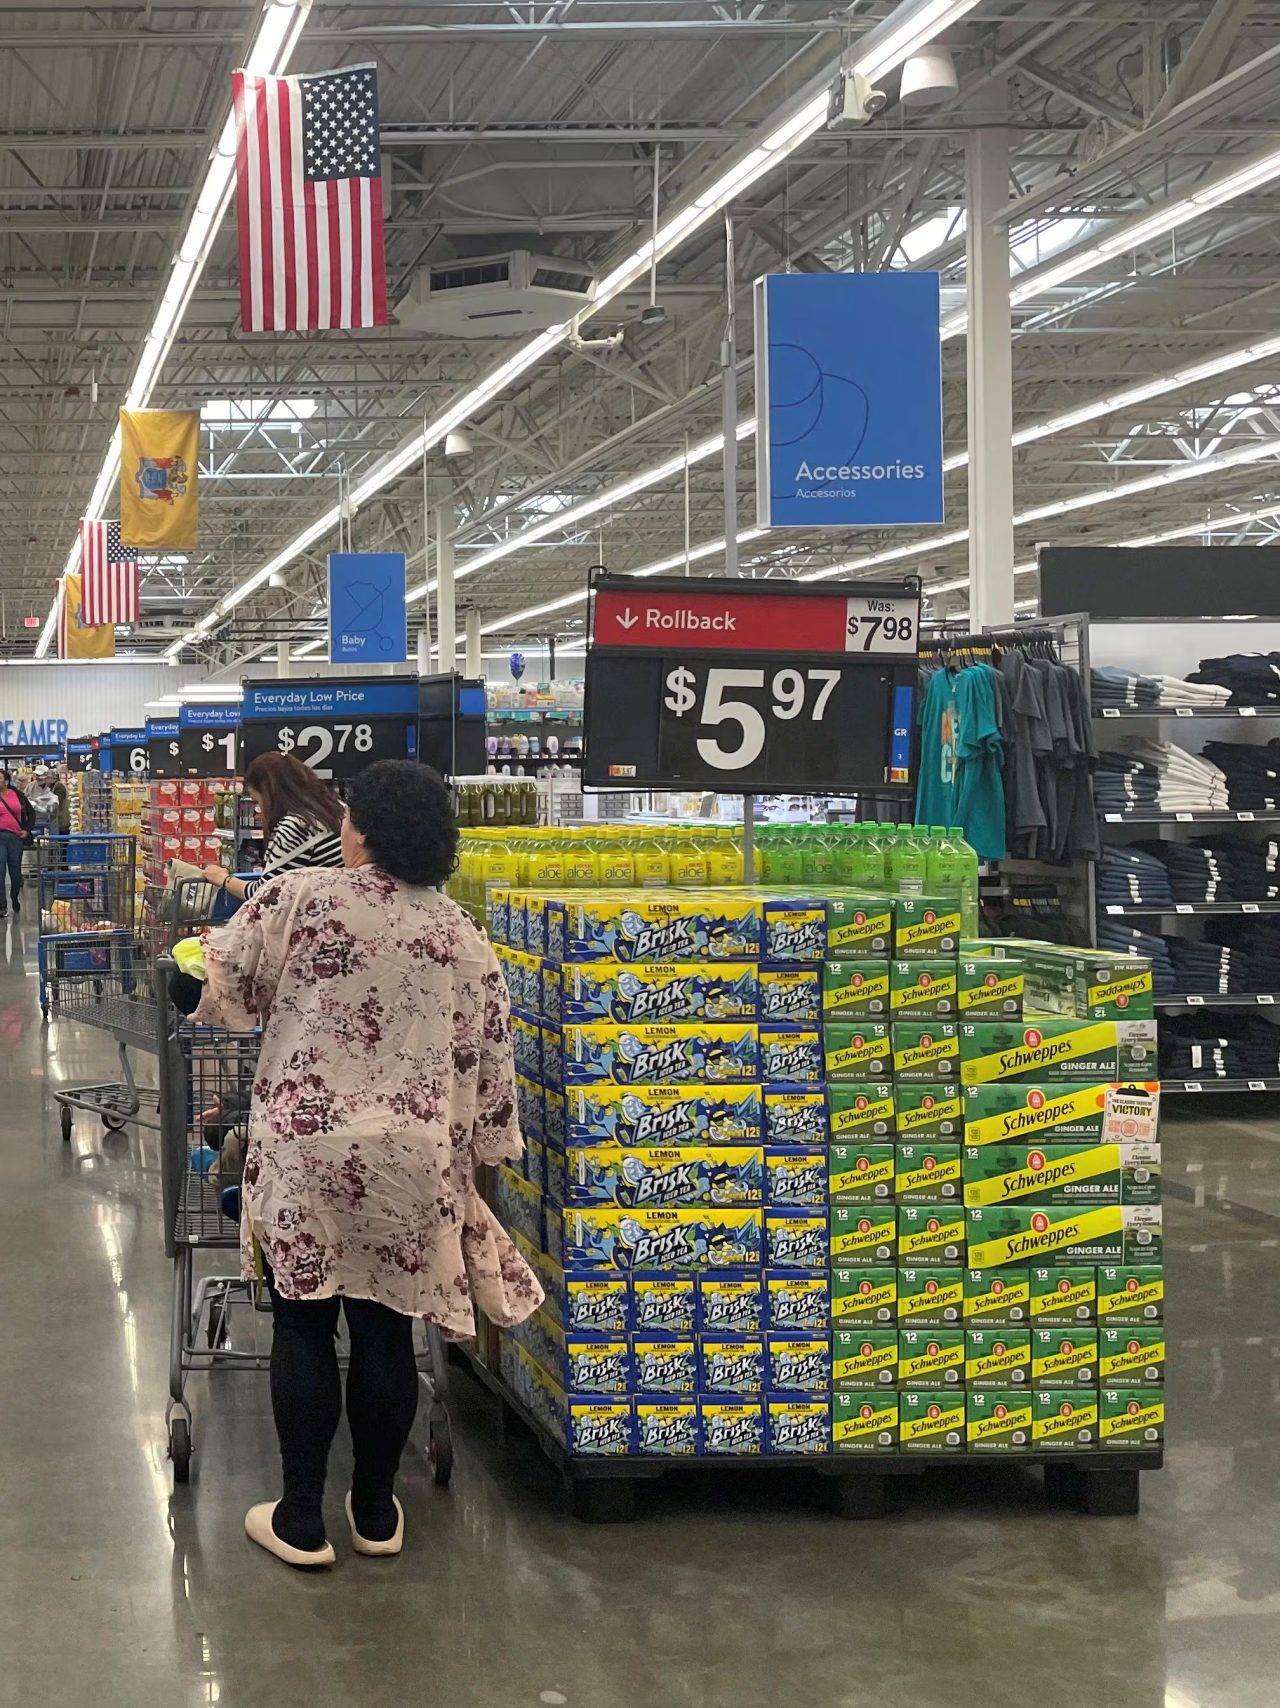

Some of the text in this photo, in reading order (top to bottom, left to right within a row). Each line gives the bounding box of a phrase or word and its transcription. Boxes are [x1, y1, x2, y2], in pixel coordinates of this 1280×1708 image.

[795, 460, 925, 482] Accessories
[796, 487, 856, 498] Accesorios
[867, 600, 895, 613] Was:
[646, 609, 736, 631] Rollback
[341, 635, 366, 647] Baby
[254, 690, 365, 705] Everyday Low Price
[188, 710, 224, 718] Everyday
[894, 728, 907, 737] GR
[833, 902, 845, 910] 12
[837, 920, 885, 942] Schweppes
[906, 918, 955, 941] Schweppes
[745, 943, 755, 953] 12
[834, 981, 883, 1004] Schweppes
[968, 981, 1017, 1003] Schweppes
[645, 1027, 676, 1035] LEMON
[962, 1025, 975, 1034] 12
[834, 1042, 883, 1065] Schweppes
[999, 1039, 1072, 1074] Schweppes
[1060, 1062, 1116, 1071] GINGER ALE
[648, 1088, 679, 1096] LEMON
[966, 1087, 979, 1095] 12
[904, 1104, 953, 1126] Schweppes
[1112, 1104, 1152, 1116] VICTORY
[1002, 1100, 1075, 1136] Schweppes
[745, 1127, 755, 1137] 12
[1002, 1162, 1075, 1197] Schweppes
[1063, 1184, 1119, 1193] GINGER ALE
[646, 1212, 678, 1220] LEMON
[970, 1209, 983, 1218] 12
[841, 1227, 891, 1249] Schweppes
[1006, 1224, 1079, 1260] Schweppes
[745, 1251, 756, 1261] 12
[1066, 1246, 1121, 1255] GINGER ALE
[842, 1289, 891, 1311] Schweppes
[974, 1288, 1024, 1311] Schweppes
[1108, 1286, 1158, 1309] Schweppes
[841, 1395, 851, 1404] 12
[843, 1413, 892, 1436] Schweppes
[977, 1412, 1027, 1435] Schweppes
[1109, 1409, 1159, 1432] Schweppes
